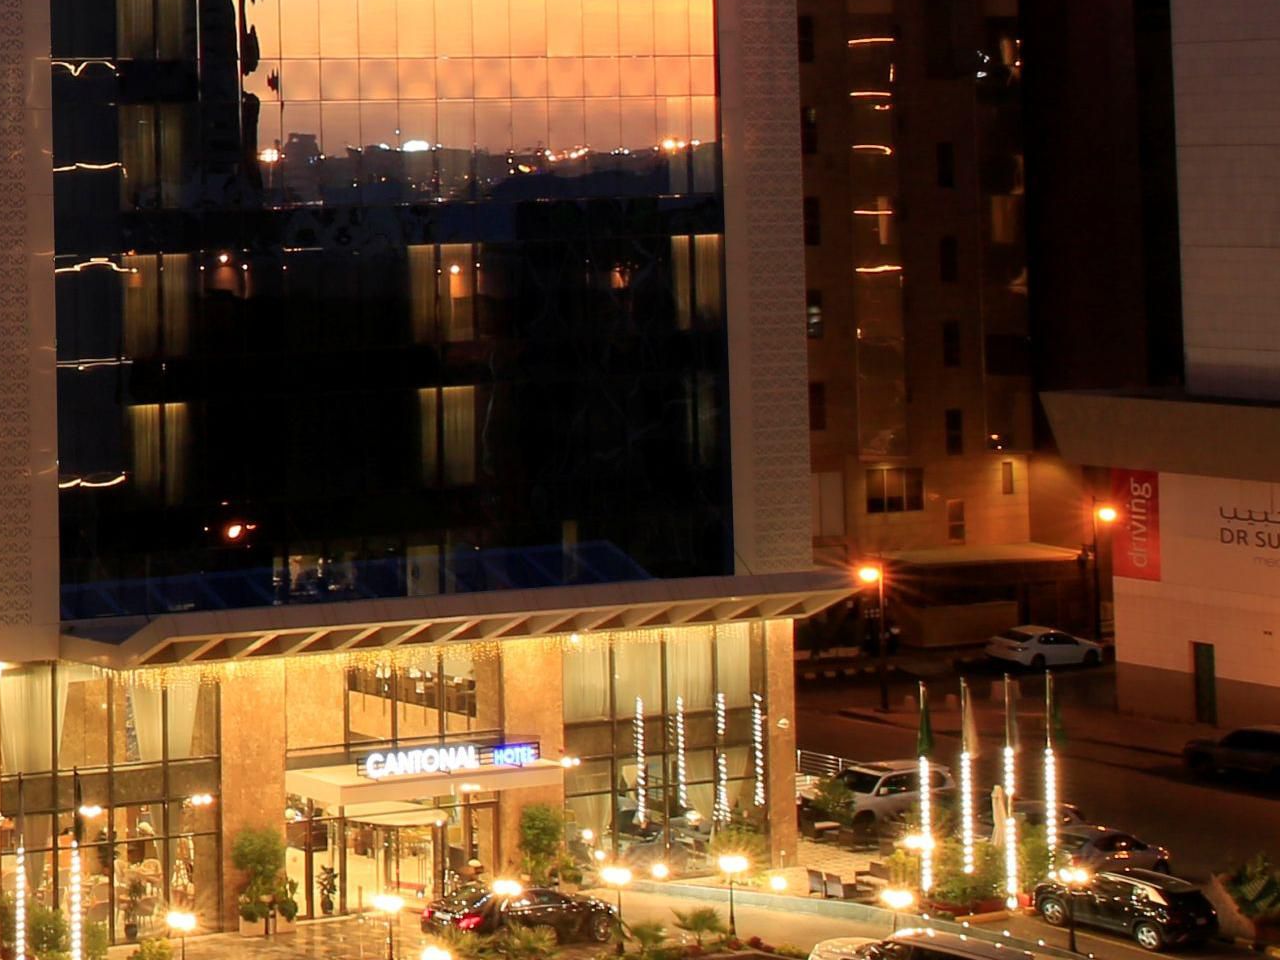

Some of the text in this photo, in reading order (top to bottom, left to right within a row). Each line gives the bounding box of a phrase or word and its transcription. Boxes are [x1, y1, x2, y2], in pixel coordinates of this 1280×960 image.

[1126, 477, 1153, 569] driving
[1220, 527, 1249, 546] DR
[366, 745, 536, 778] CANTONAL HOTEL
